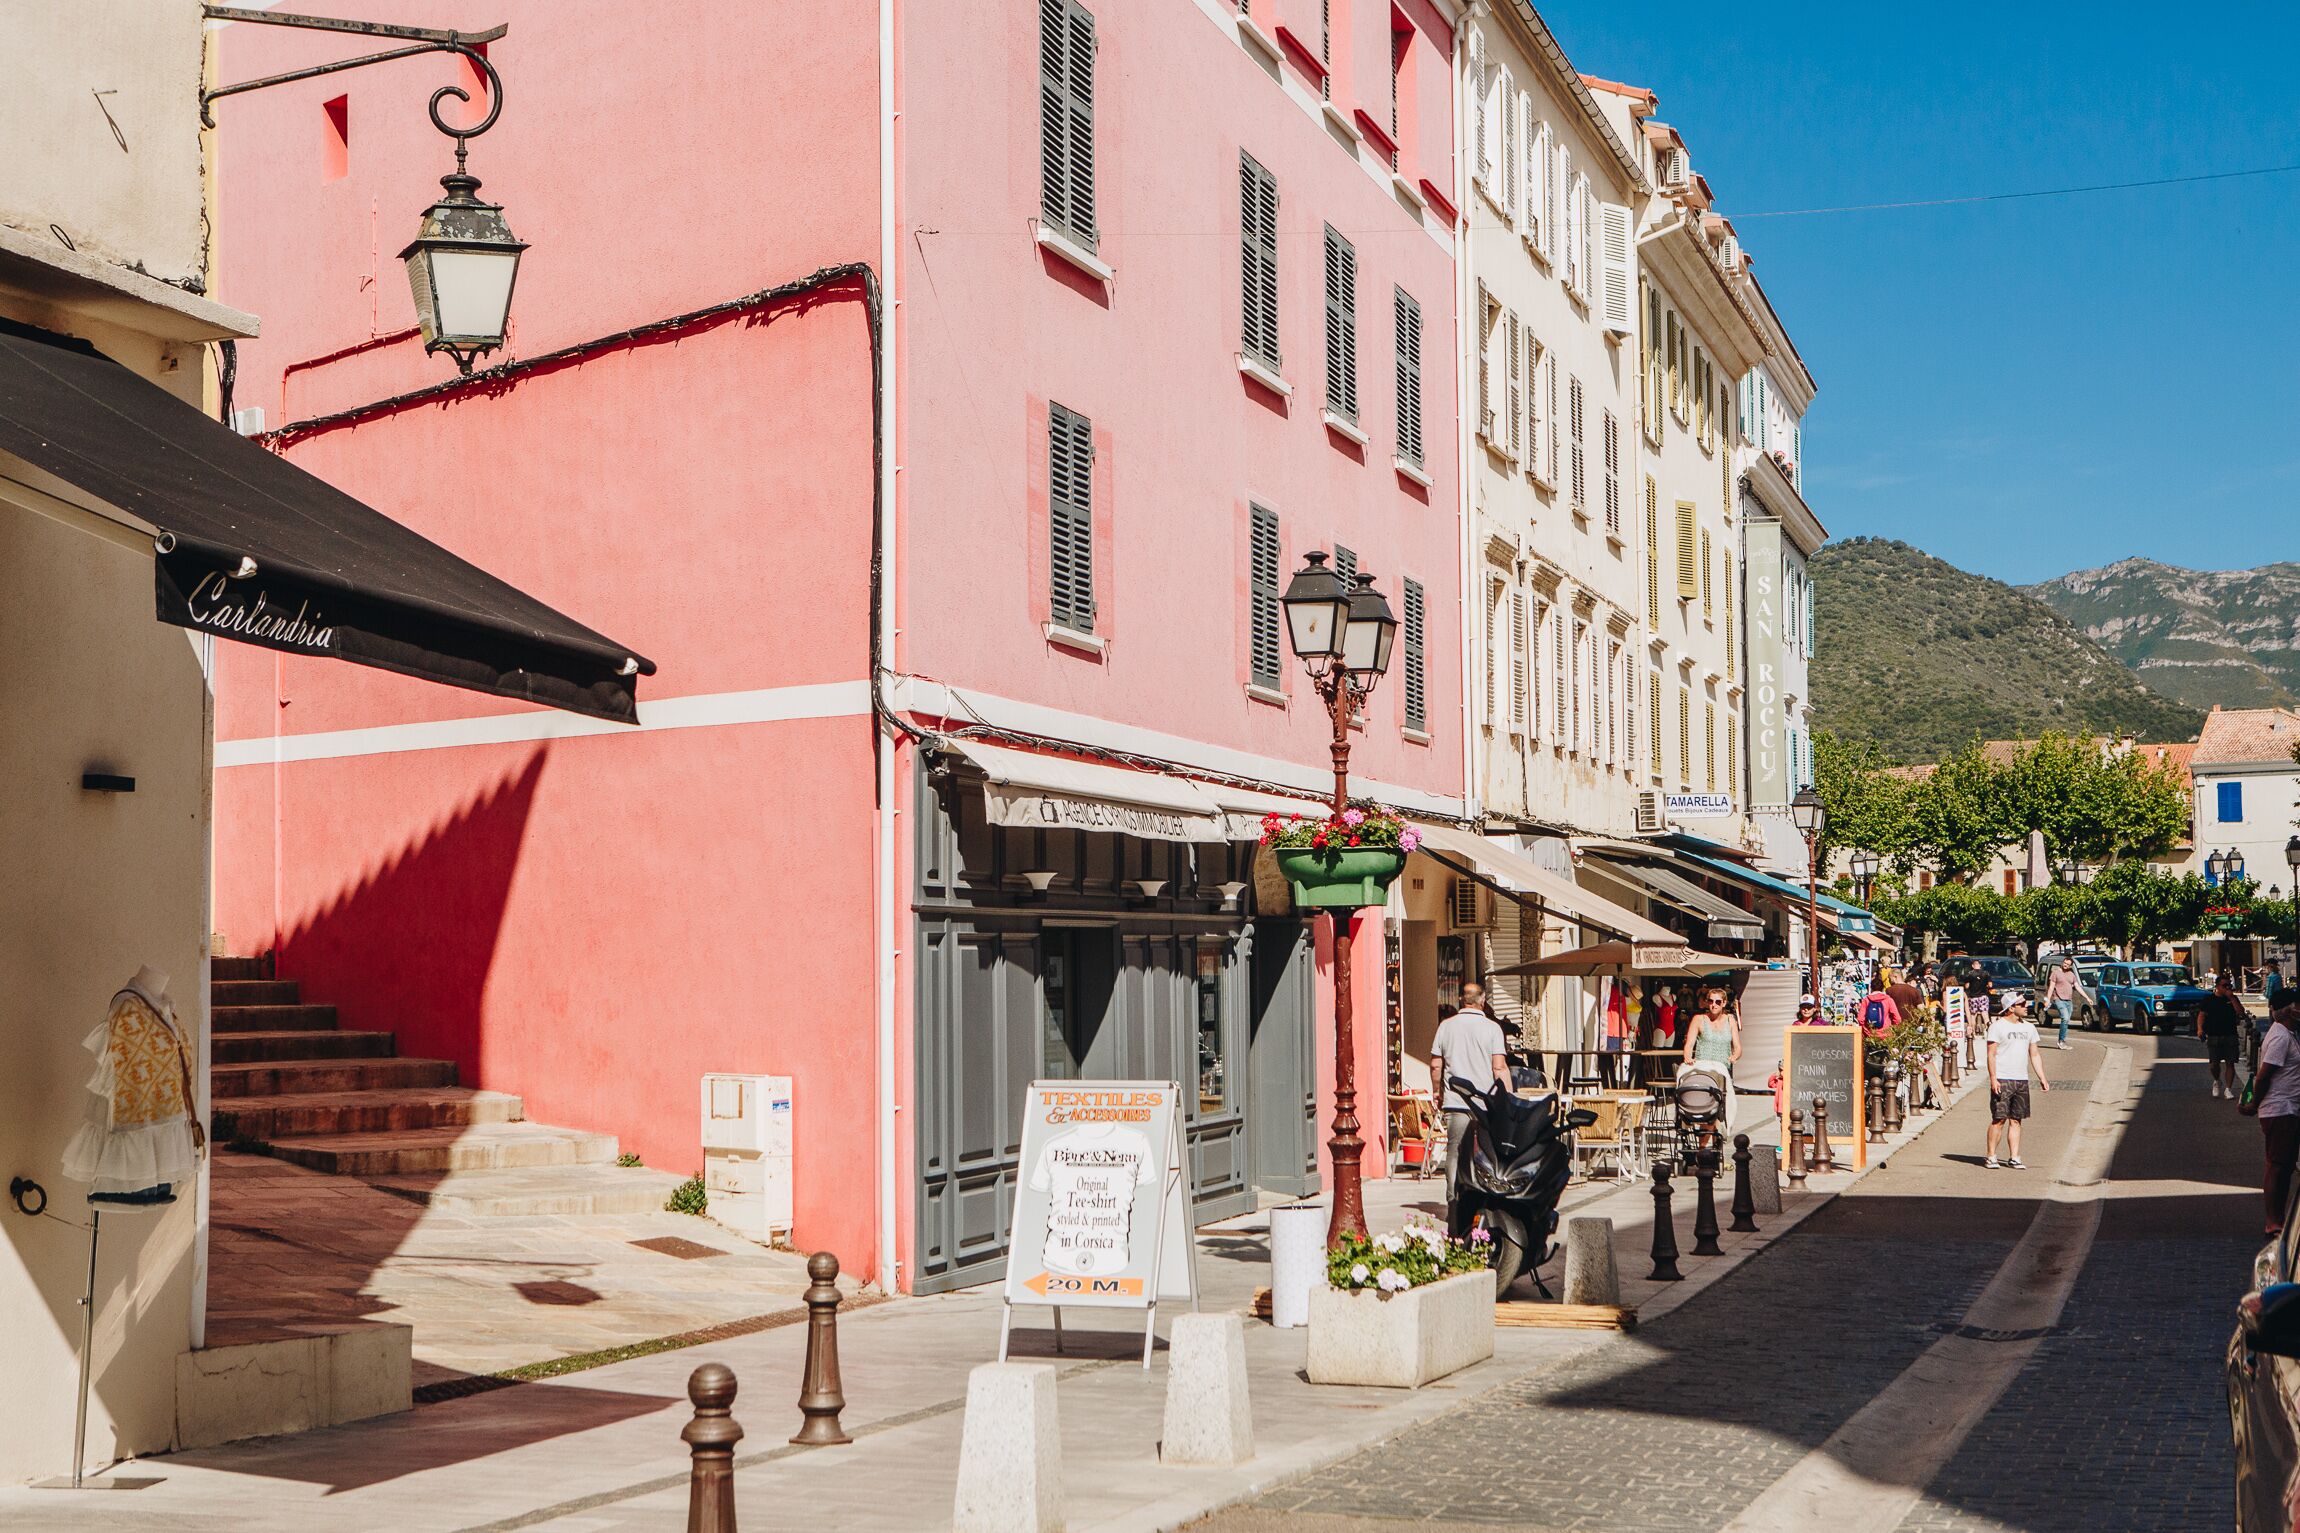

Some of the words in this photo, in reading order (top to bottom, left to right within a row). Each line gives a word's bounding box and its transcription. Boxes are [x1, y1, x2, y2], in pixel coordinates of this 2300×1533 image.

[188, 571, 333, 648] Carlandria
[1756, 575, 1774, 639] SAN
[1758, 663, 1776, 771] ROCCU
[1666, 796, 1728, 807] TAMARELLA
[1062, 800, 1104, 826] AGENCE
[1798, 1064, 1827, 1076] PANINI
[1039, 1091, 1163, 1107] TEXTILES
[1069, 1107, 1151, 1121] ACCESSOIRES
[1076, 1175, 1109, 1192] Original
[1067, 1191, 1117, 1208] Tee-shirt
[1056, 1211, 1080, 1226] styled
[1081, 1212, 1089, 1226] &
[1092, 1211, 1121, 1230] printed
[1060, 1231, 1071, 1248] in
[1075, 1231, 1114, 1249] Corsica
[1047, 1279, 1082, 1291] 20
